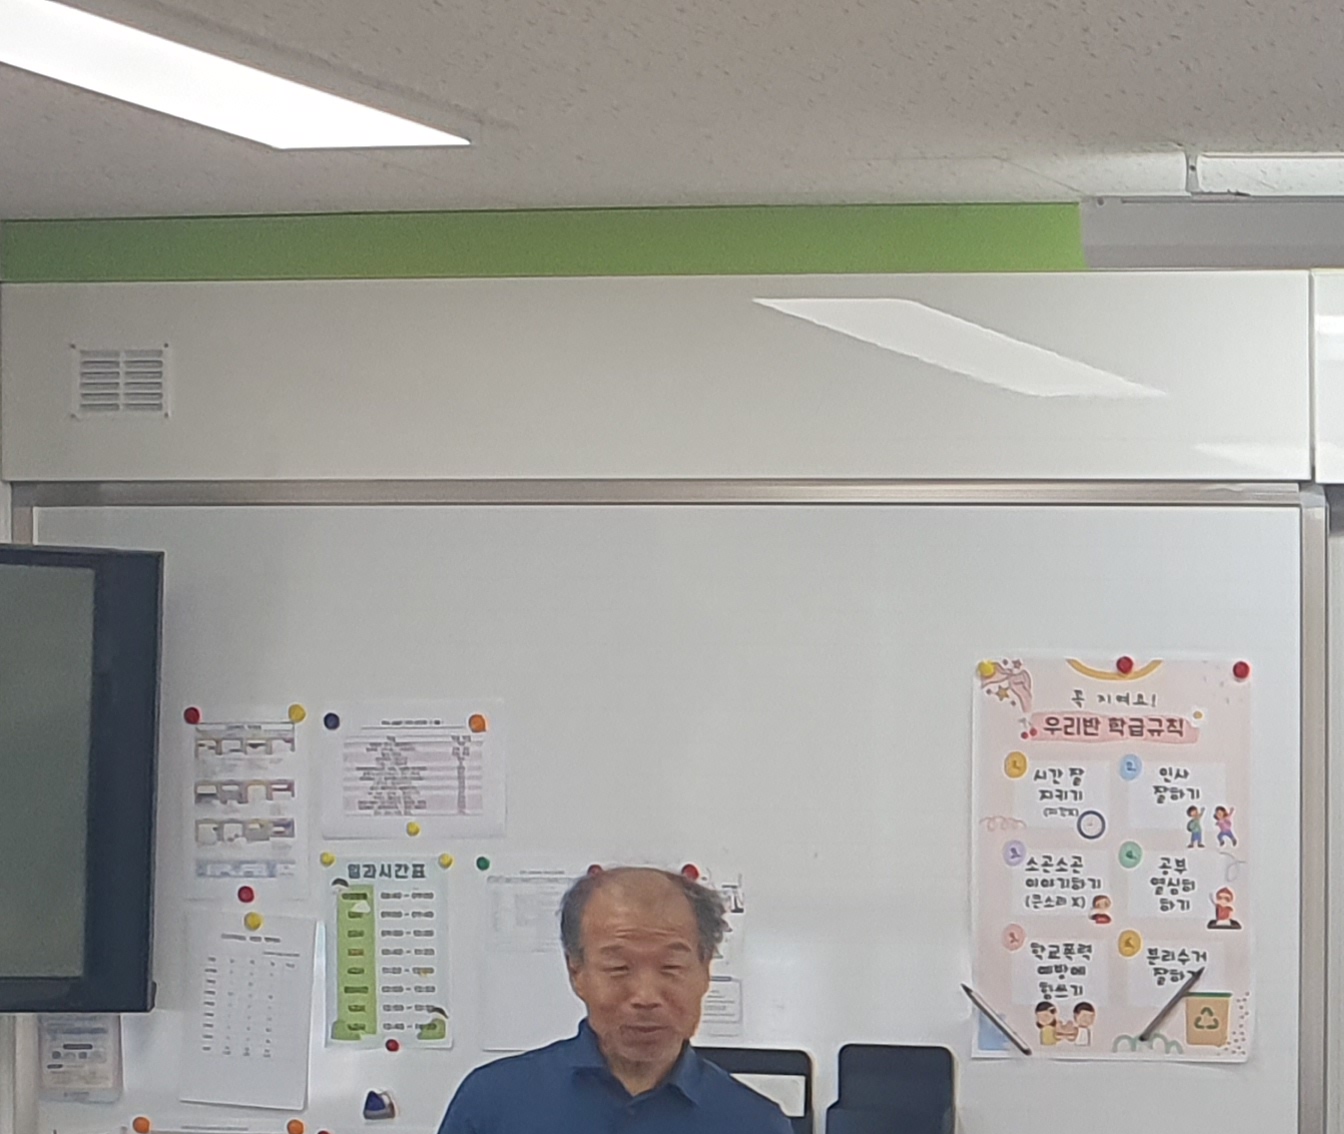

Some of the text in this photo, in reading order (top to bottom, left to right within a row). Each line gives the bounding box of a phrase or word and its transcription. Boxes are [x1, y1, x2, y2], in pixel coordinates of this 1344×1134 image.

[1043, 716, 1184, 738] 우리반 학급규칙
[1034, 767, 1085, 786] 시간 잘
[1159, 768, 1189, 783] 인사
[1039, 788, 1083, 801] 지키기
[1152, 785, 1200, 804] 잘하기
[348, 864, 425, 879] 일과시간표
[1025, 855, 1083, 873] 소곤소곤
[1158, 857, 1187, 875] 공부
[1025, 877, 1101, 890] 이야기하기
[1150, 877, 1195, 895] 열심히
[1159, 898, 1190, 912] 하기
[1030, 942, 1092, 960] 학교폭력
[1146, 948, 1207, 965] 분리수거
[1037, 964, 1086, 980] 예방에
[1039, 982, 1083, 1000] 힘쓰기
